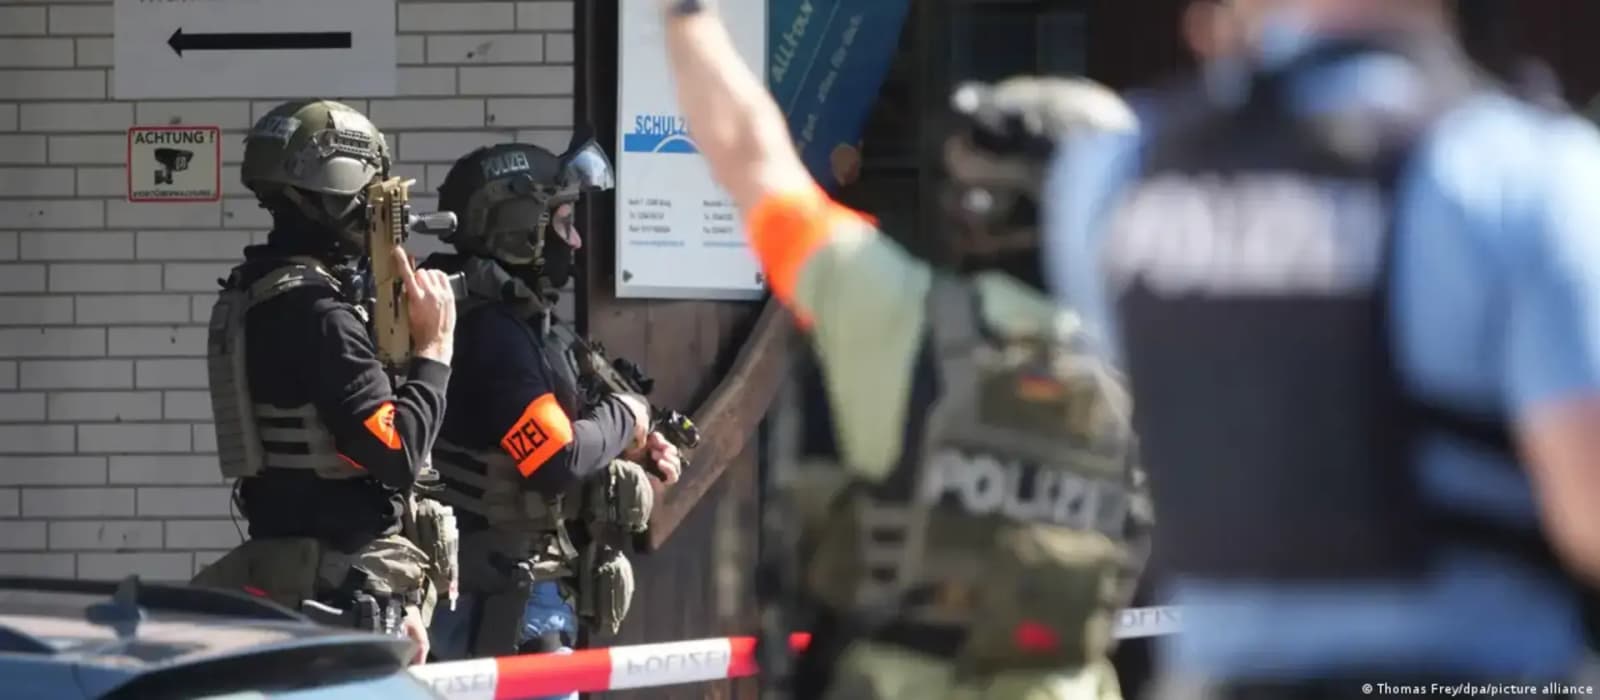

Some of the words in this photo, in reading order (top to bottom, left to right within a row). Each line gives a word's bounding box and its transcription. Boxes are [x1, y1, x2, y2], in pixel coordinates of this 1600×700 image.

[635, 115, 689, 136] SCHULZ
[135, 130, 204, 144] ACHTUNG
[504, 417, 550, 465] IZEI
